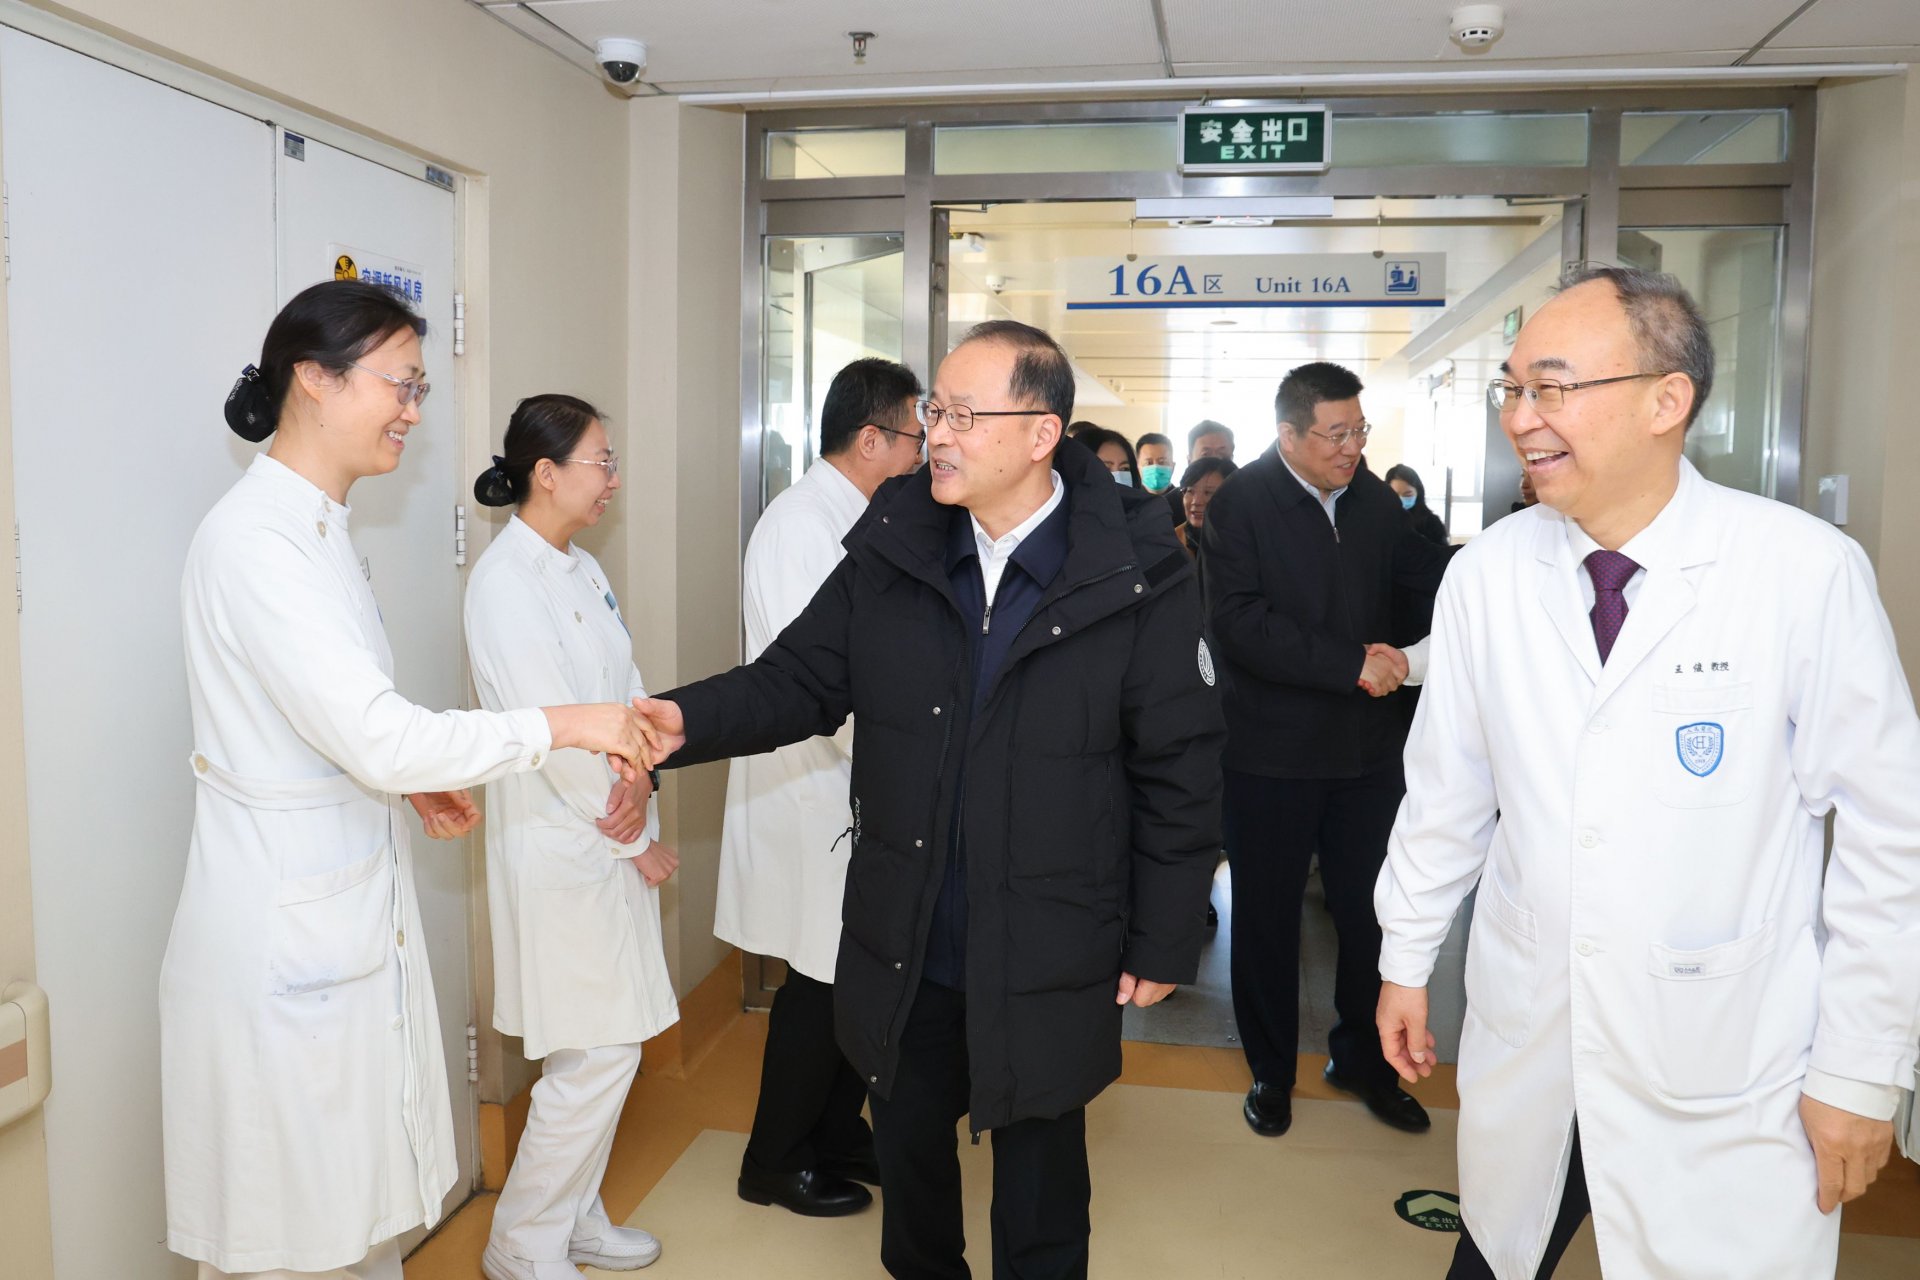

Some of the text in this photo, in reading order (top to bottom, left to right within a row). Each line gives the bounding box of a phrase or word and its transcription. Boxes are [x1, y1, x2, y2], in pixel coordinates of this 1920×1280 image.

[1199, 117, 1309, 144] 安全出口
[1220, 144, 1287, 160] EXIT
[1255, 276, 1351, 294] Unit 16A
